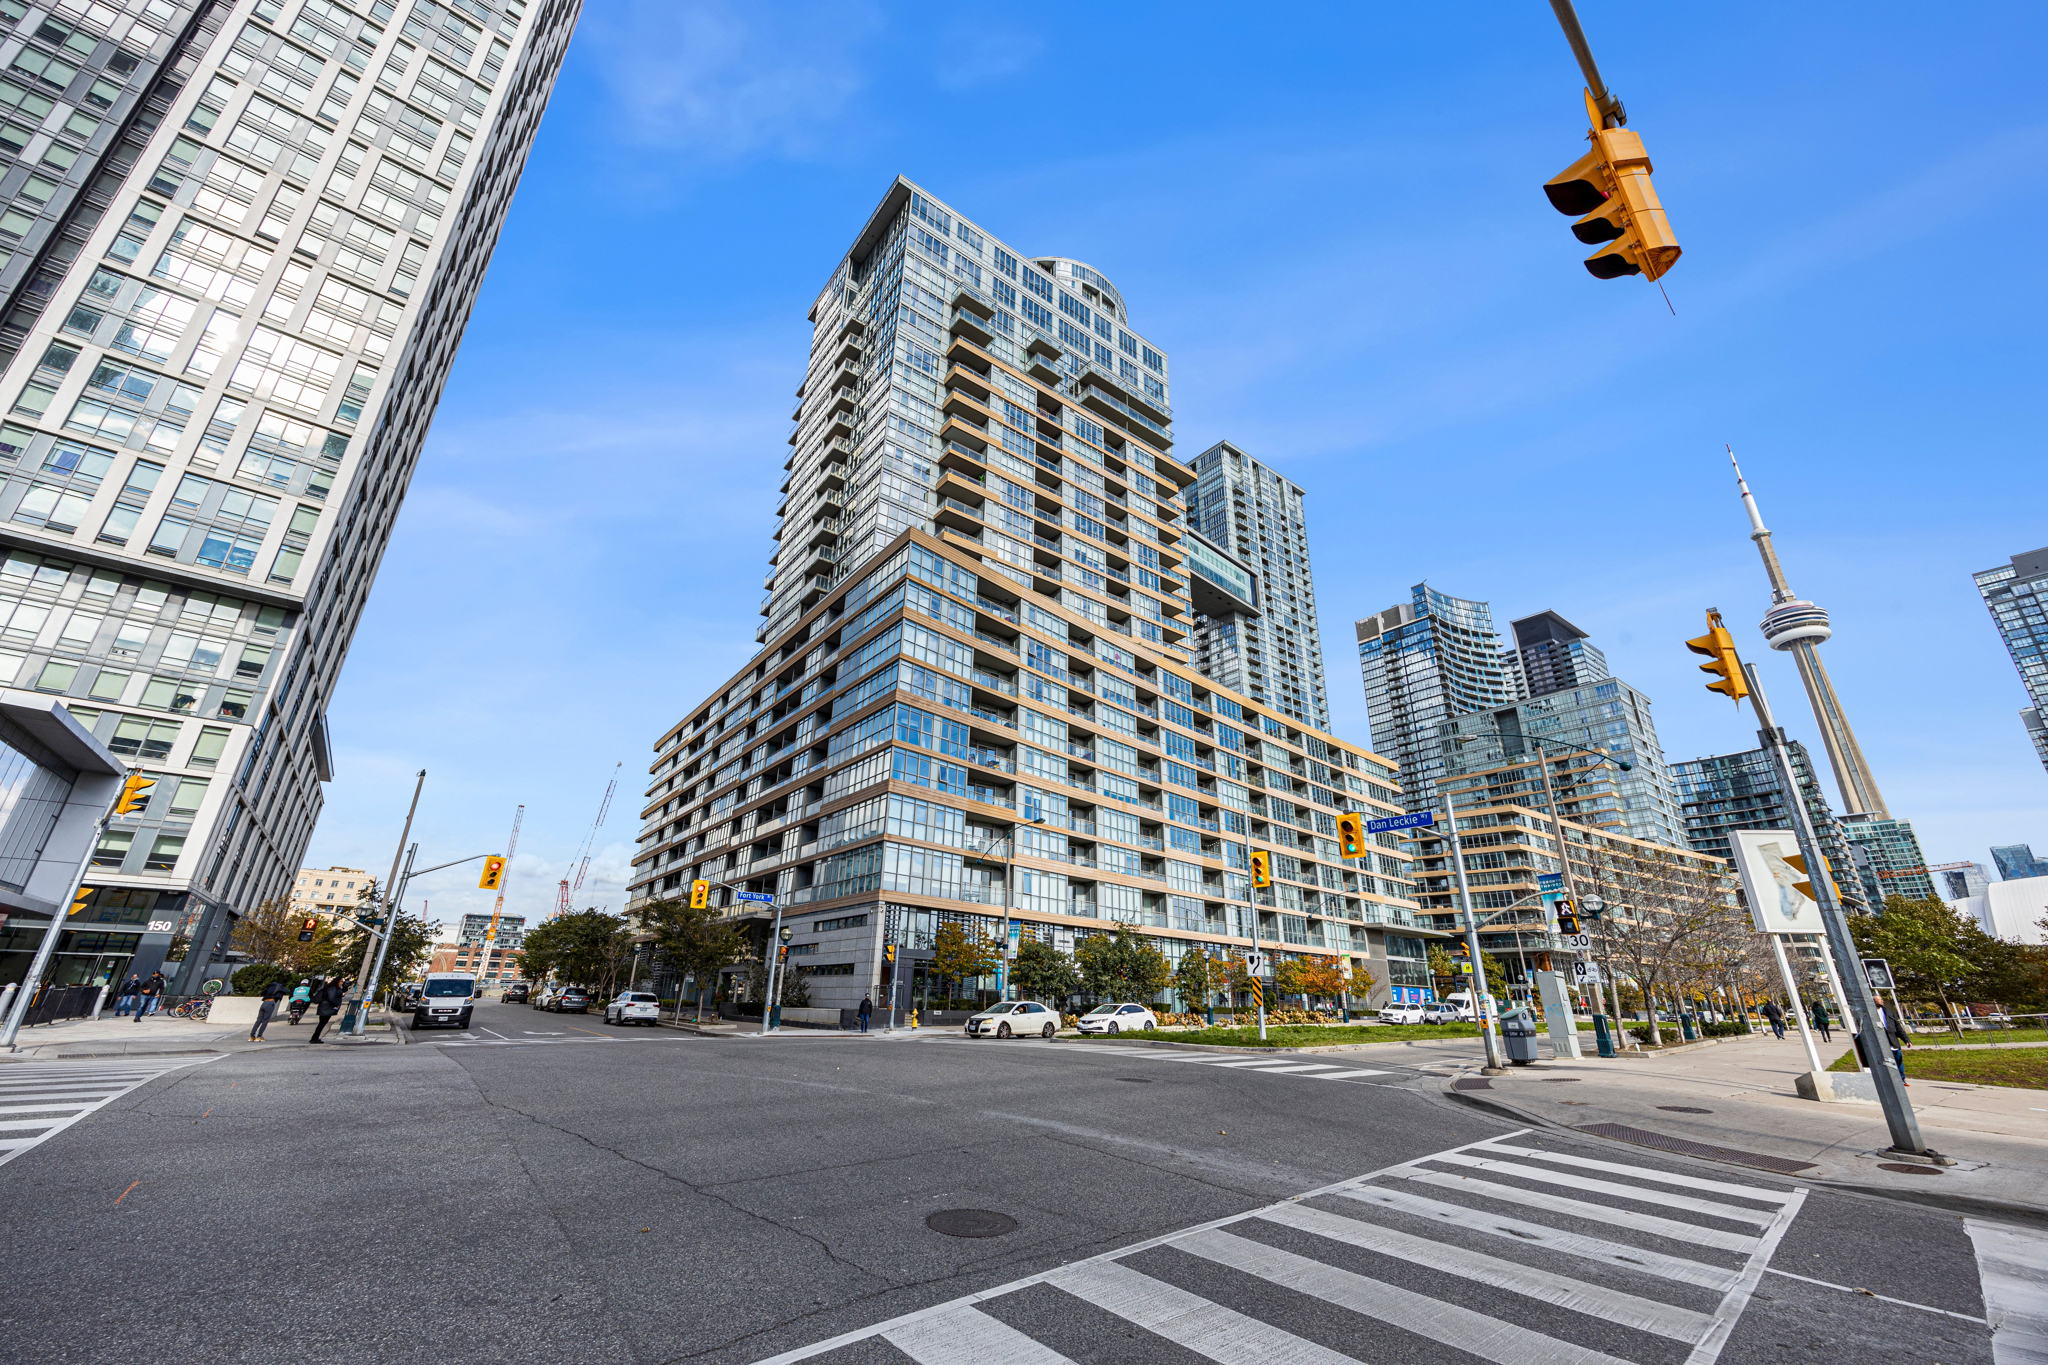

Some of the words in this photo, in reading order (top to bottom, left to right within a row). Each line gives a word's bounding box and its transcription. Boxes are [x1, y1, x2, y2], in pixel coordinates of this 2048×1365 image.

[1370, 821, 1387, 830] Dan
[1389, 815, 1418, 828] Leckie
[740, 891, 751, 899] Fort
[147, 920, 172, 931] 150
[1570, 934, 1589, 947] 30
